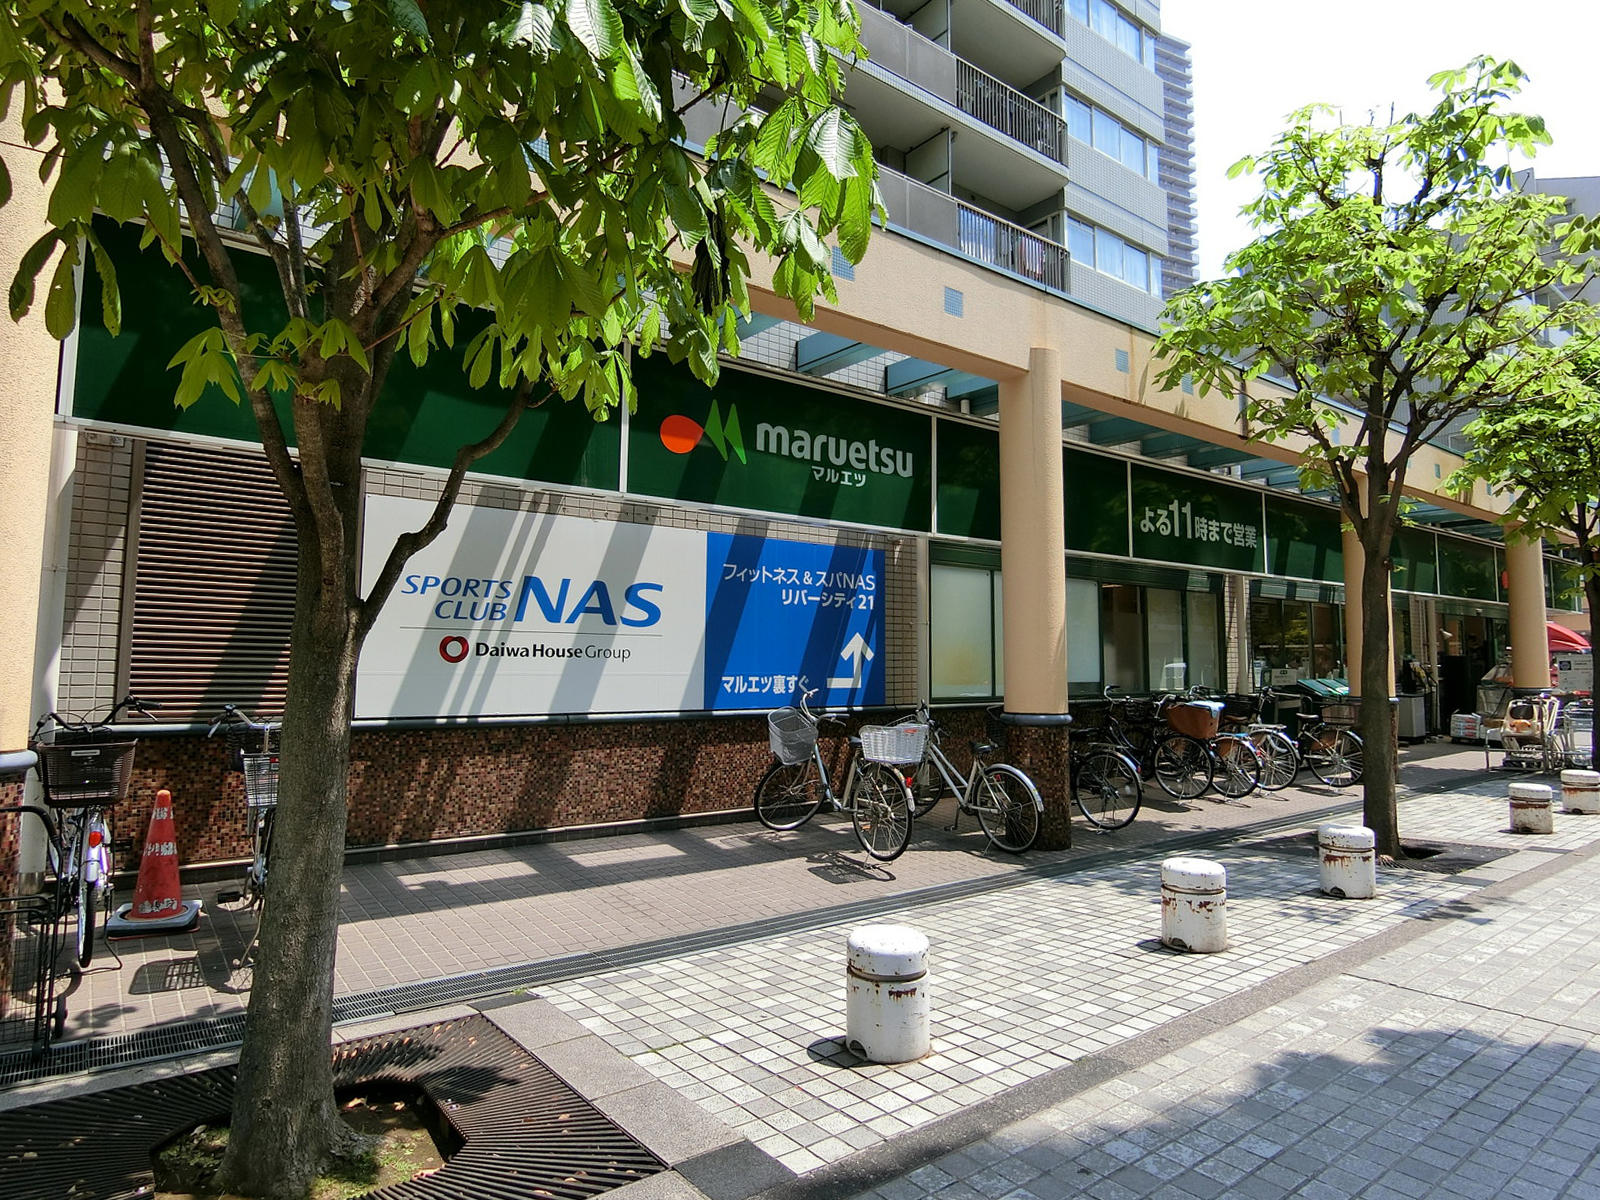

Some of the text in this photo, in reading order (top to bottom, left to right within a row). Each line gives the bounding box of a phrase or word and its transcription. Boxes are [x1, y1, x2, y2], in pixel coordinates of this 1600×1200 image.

[756, 422, 913, 478] maruetsu
[811, 465, 866, 487] マルエツ
[1140, 499, 1257, 548] よる11時まで営業
[401, 574, 513, 599] SPORTS
[513, 575, 664, 628] NAS
[781, 588, 874, 610] リバーシティ21
[434, 600, 507, 621] CLUB
[475, 642, 631, 662] Daiwa House Group
[722, 674, 810, 695] マルエツ裏すぐ
